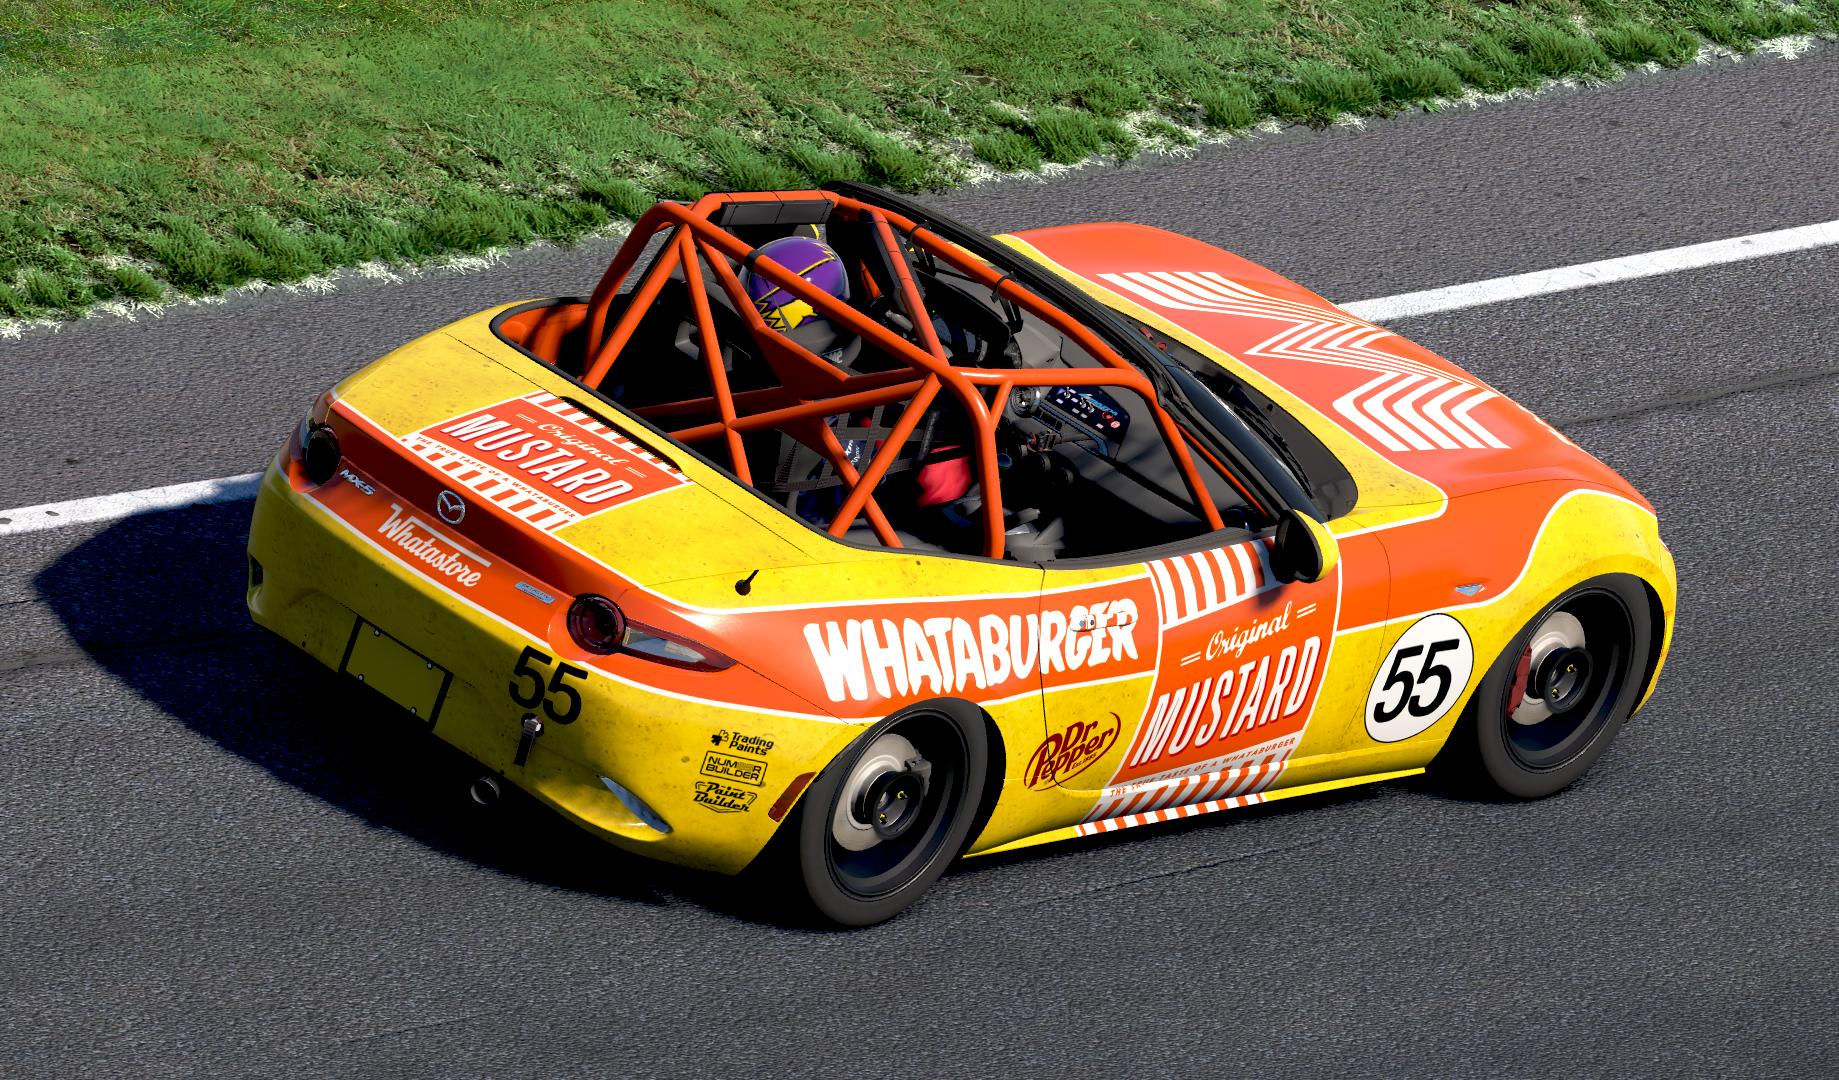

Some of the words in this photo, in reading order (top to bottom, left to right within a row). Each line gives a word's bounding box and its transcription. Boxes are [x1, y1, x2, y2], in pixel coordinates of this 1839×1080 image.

[440, 413, 633, 504] MUSTARD
[537, 423, 628, 466] Original
[340, 469, 376, 496] MX-5
[416, 436, 433, 445] THE
[435, 444, 457, 456] TRUE
[459, 455, 487, 469] TASTE
[488, 469, 502, 477] OF
[511, 481, 576, 518] WHATABURGER
[377, 502, 492, 587] Whatastore
[803, 598, 1139, 702] WHATABURGER
[1205, 600, 1292, 661] Original
[509, 645, 588, 725] 55
[1129, 635, 1322, 770] MUSTARD
[1374, 638, 1460, 724] 55
[708, 756, 762, 773] NUMR
[728, 740, 768, 756] Paints
[732, 732, 774, 750] Trading
[1027, 727, 1114, 789] Pepper
[1060, 720, 1099, 755] Dr
[1110, 787, 1127, 798] THE
[1131, 777, 1157, 791] TRUE
[1160, 767, 1191, 780] TASTE
[1194, 763, 1208, 772] OF
[1222, 737, 1296, 764] WHATABURGER
[693, 790, 750, 812] Builder
[705, 764, 760, 782] BUILDER
[706, 781, 747, 800] Paint
